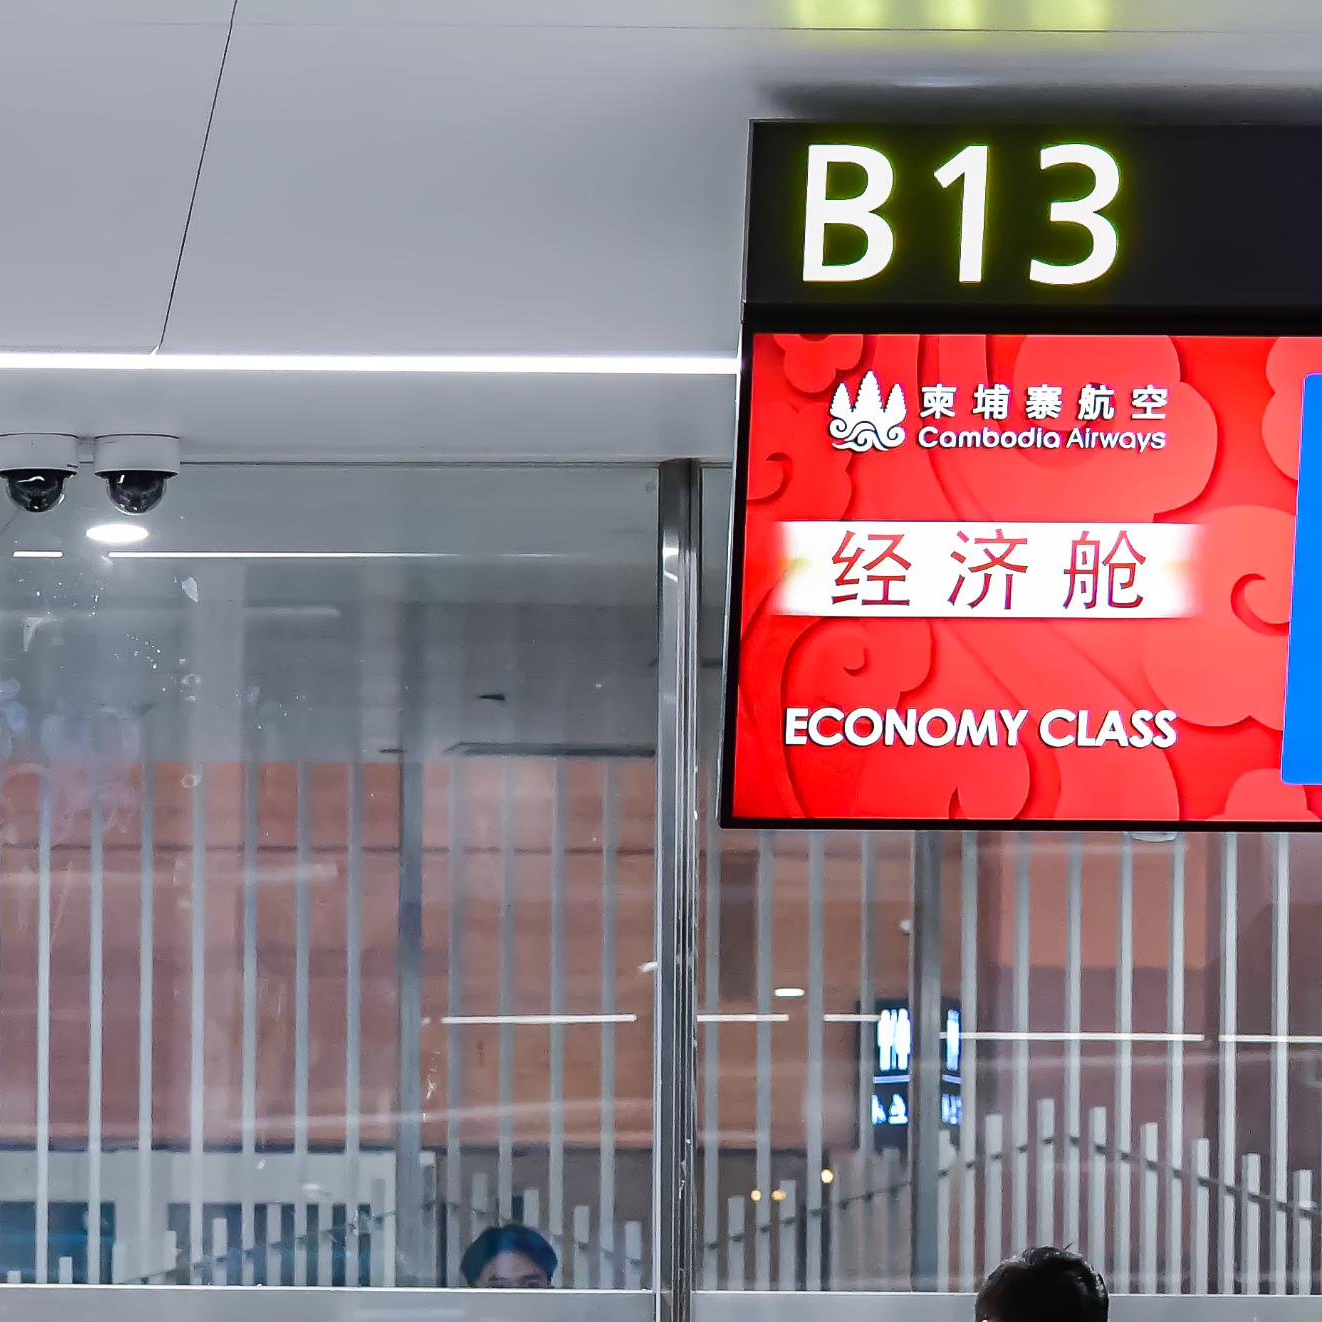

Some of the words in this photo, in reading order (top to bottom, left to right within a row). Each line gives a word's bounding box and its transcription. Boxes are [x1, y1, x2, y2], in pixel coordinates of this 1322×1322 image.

[803, 144, 1119, 284] B13
[921, 384, 1167, 419] 柬埔寨航空
[919, 427, 1060, 448] Cambodia
[1067, 428, 1165, 452] Airways
[832, 529, 1146, 609] 经济舱
[786, 708, 1028, 746] ECONOMY
[1040, 709, 1176, 747] CLASS
